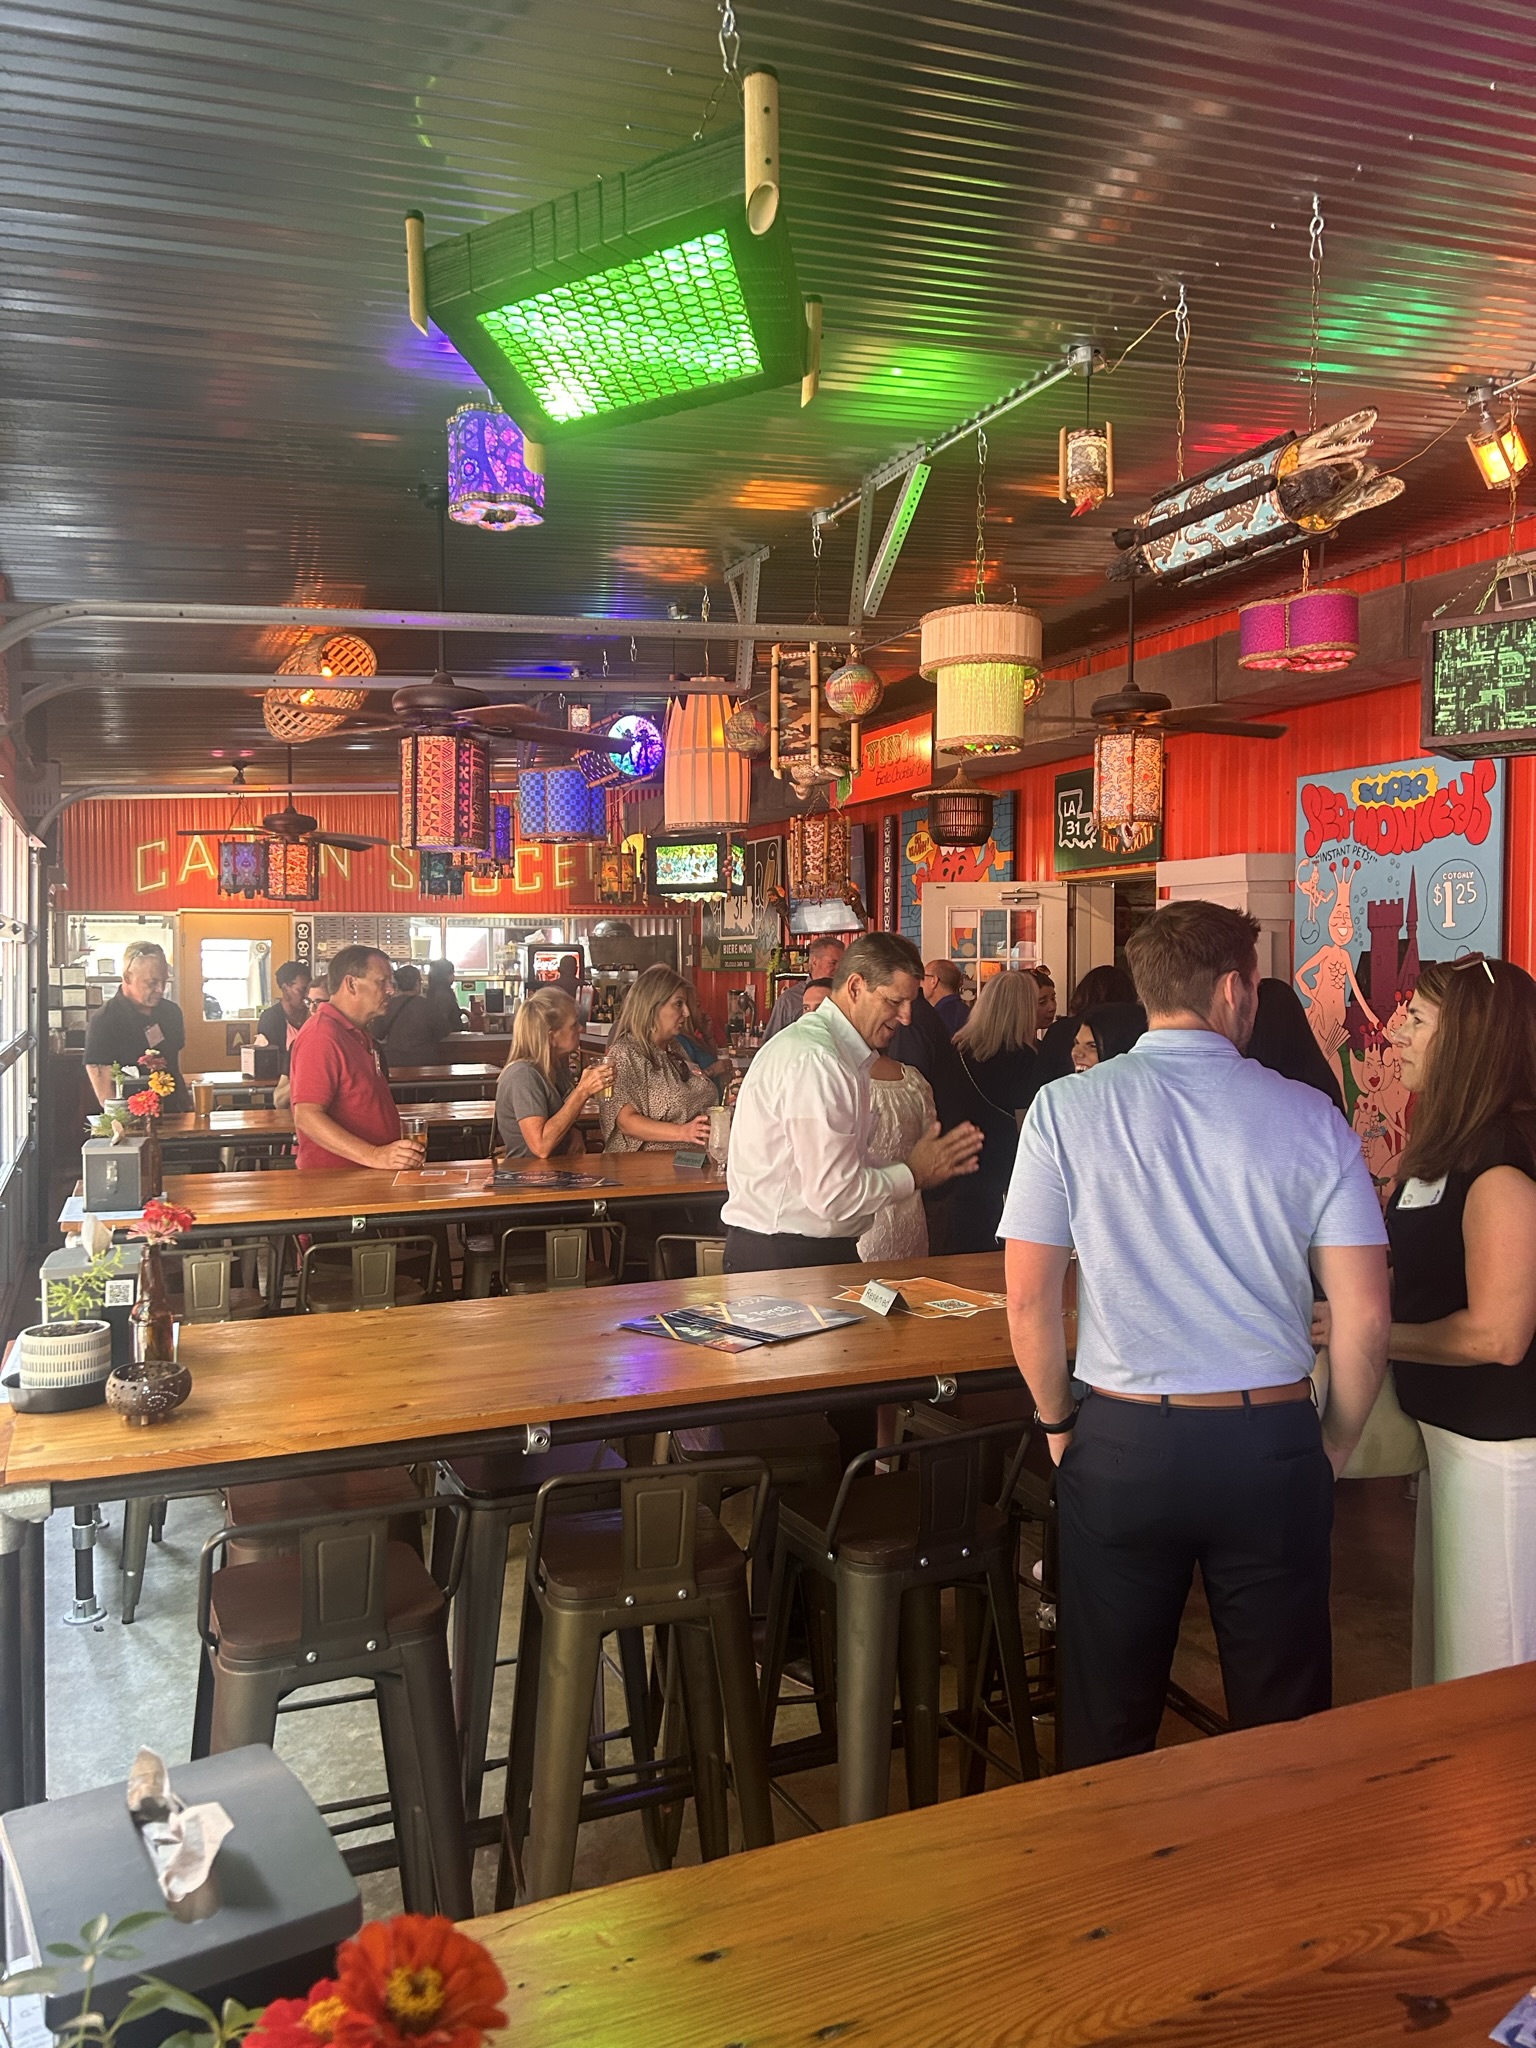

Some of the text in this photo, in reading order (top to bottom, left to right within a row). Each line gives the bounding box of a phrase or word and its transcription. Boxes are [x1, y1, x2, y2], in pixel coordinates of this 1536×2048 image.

[1358, 773, 1429, 805] SUPER
[1063, 800, 1076, 818] LA
[1066, 821, 1080, 835] 31
[1101, 823, 1154, 854] TAP OOM
[136, 834, 348, 893] CAN
[738, 943, 753, 954] NOIR
[865, 1288, 891, 1309] Reserved
